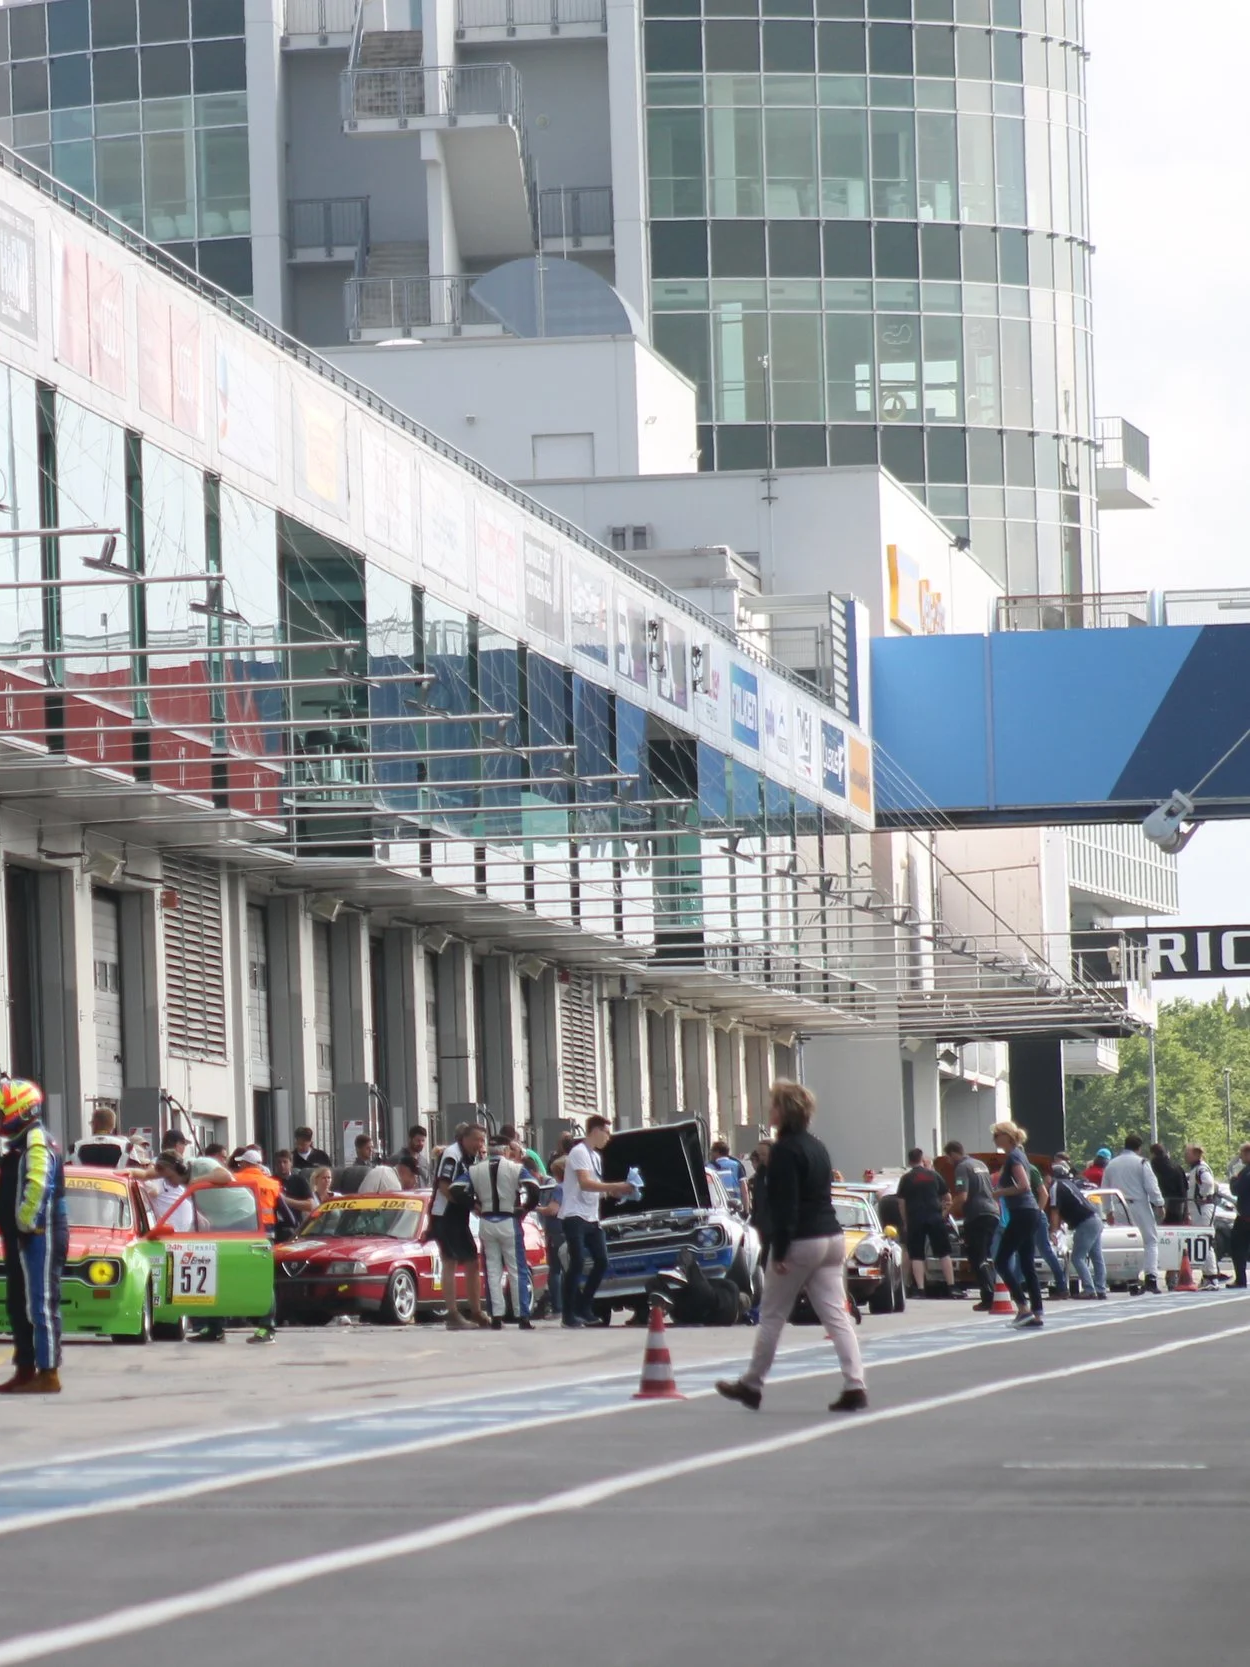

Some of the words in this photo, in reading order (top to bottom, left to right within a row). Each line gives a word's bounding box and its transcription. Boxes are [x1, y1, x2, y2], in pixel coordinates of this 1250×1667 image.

[67, 1180, 102, 1190] ADAC
[324, 1201, 357, 1211] ADAC
[379, 1200, 416, 1209] ADAC
[181, 1266, 207, 1294] 52
